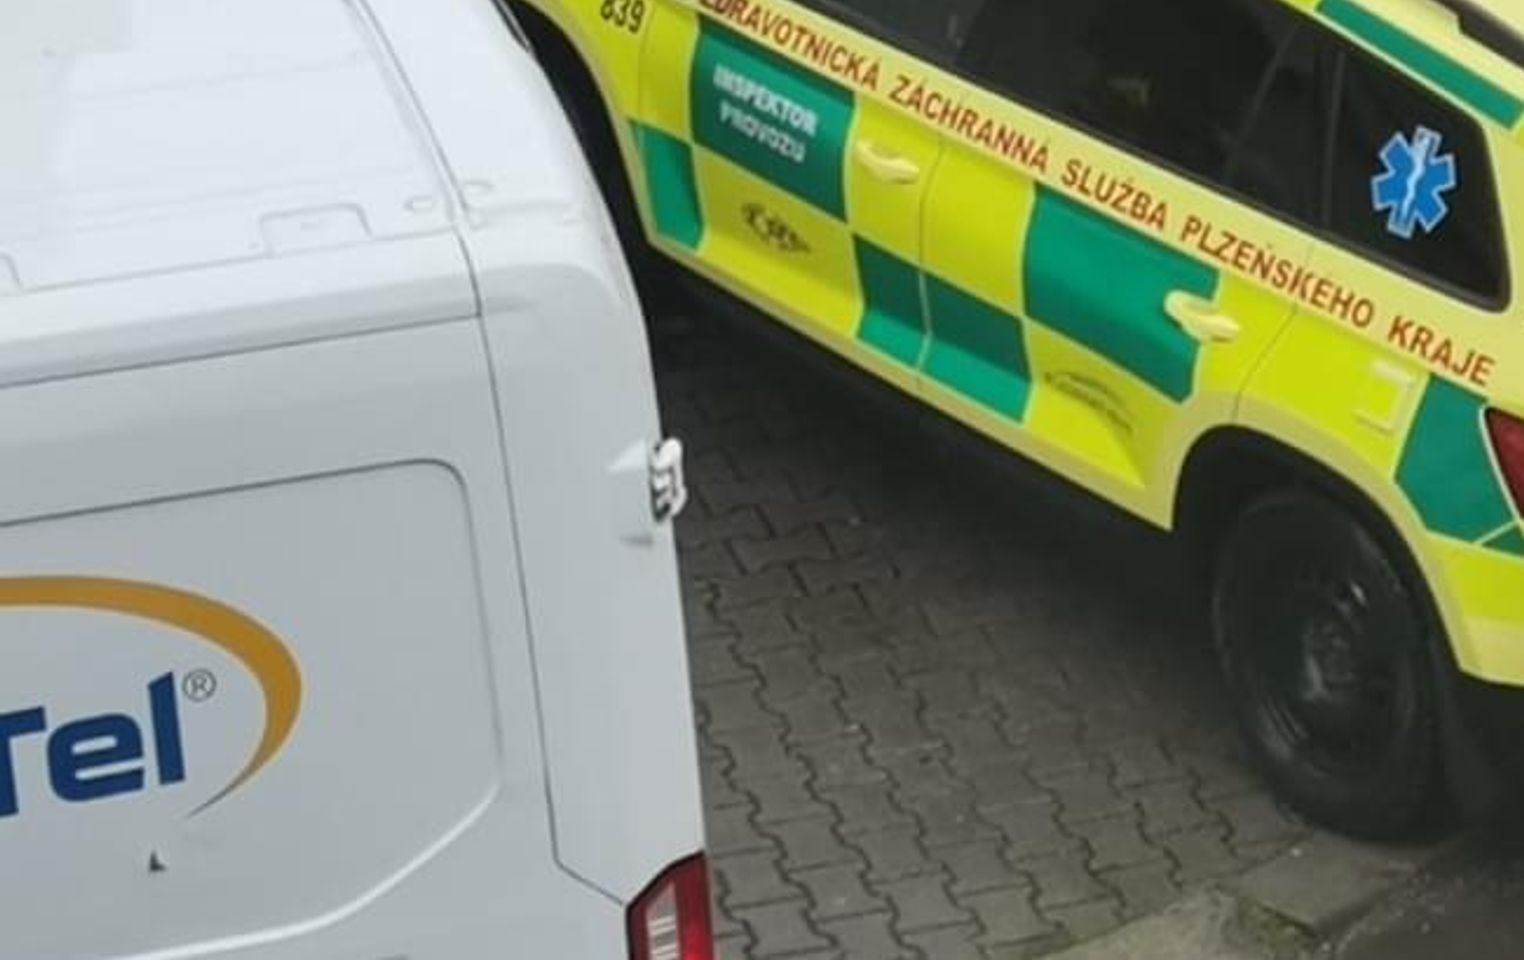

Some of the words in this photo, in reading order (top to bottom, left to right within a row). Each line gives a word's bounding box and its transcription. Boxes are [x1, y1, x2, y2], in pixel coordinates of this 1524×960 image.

[712, 62, 819, 139] INSPEKTOR
[1060, 157, 1168, 231] SLUŽBA
[1386, 314, 1496, 388] KRAJE
